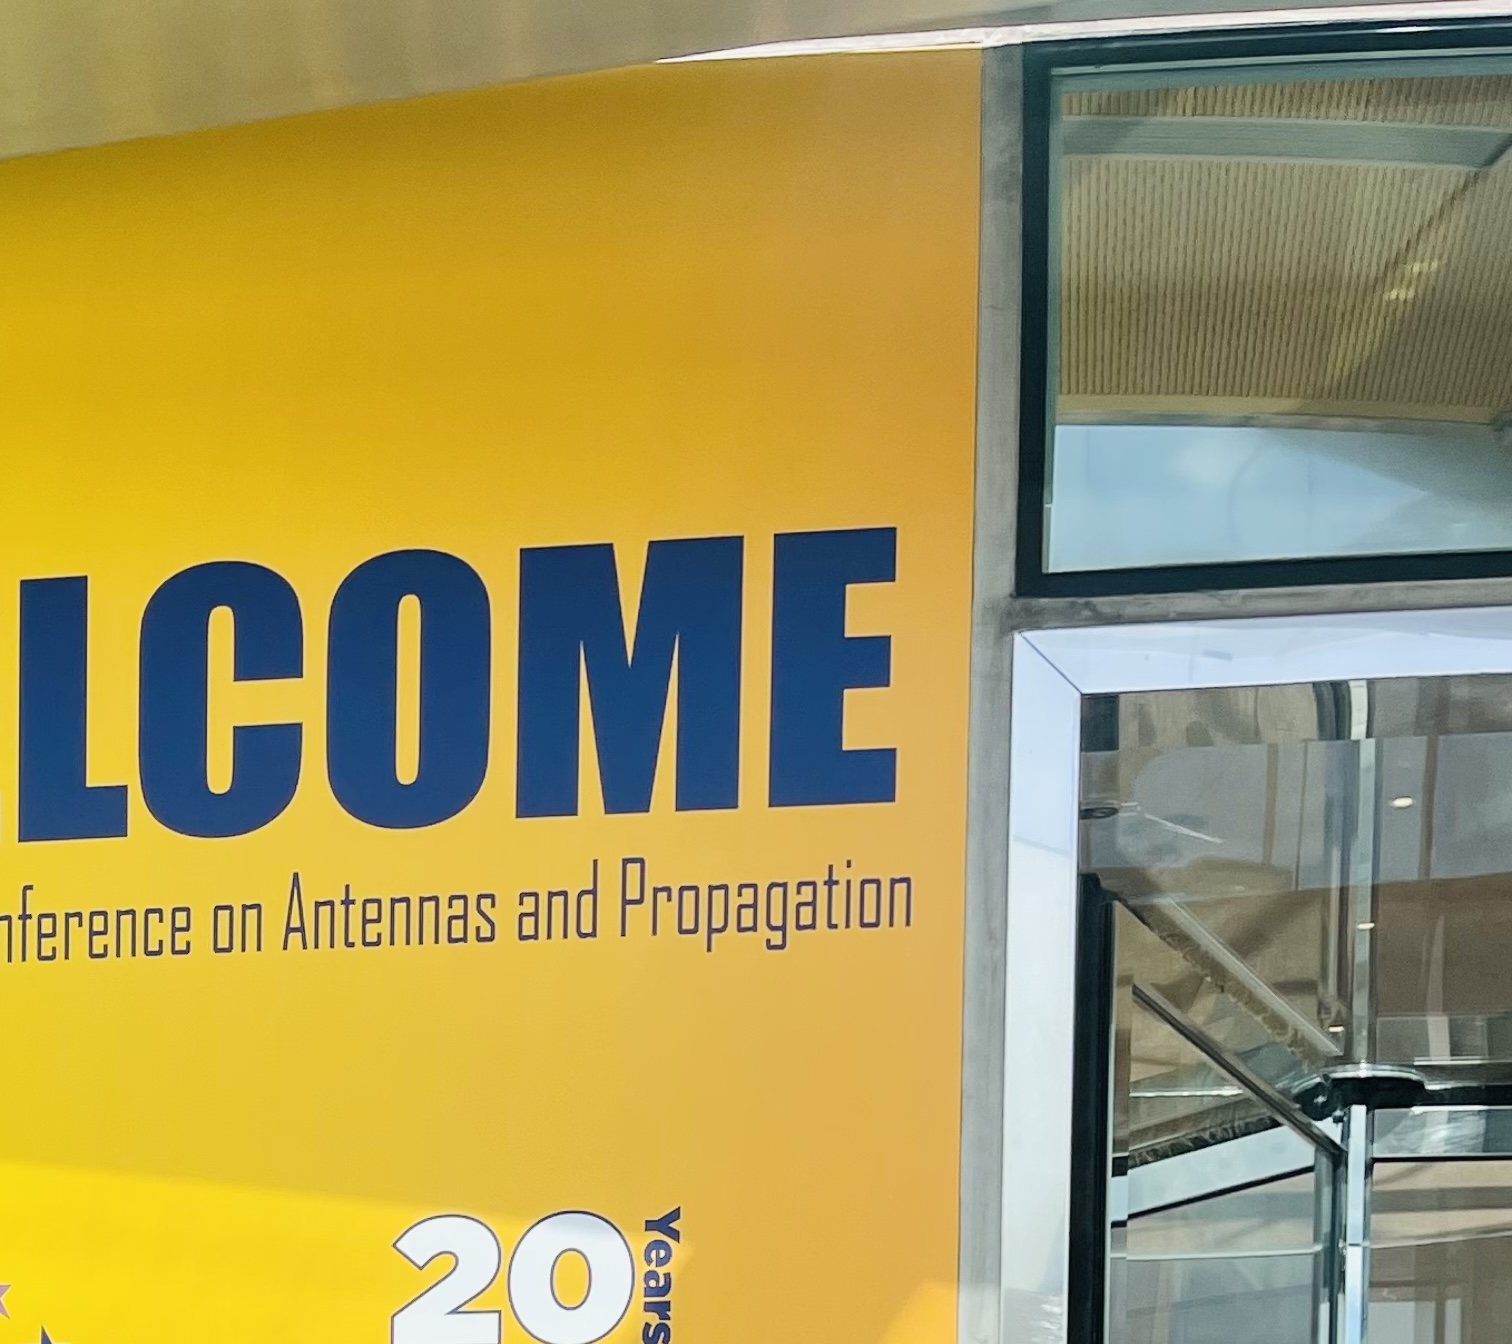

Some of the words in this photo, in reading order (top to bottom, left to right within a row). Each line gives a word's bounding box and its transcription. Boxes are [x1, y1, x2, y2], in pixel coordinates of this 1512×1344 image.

[213, 903, 262, 954] on
[282, 871, 496, 951] Antennas
[518, 858, 599, 942] and
[620, 857, 913, 954] Propagation
